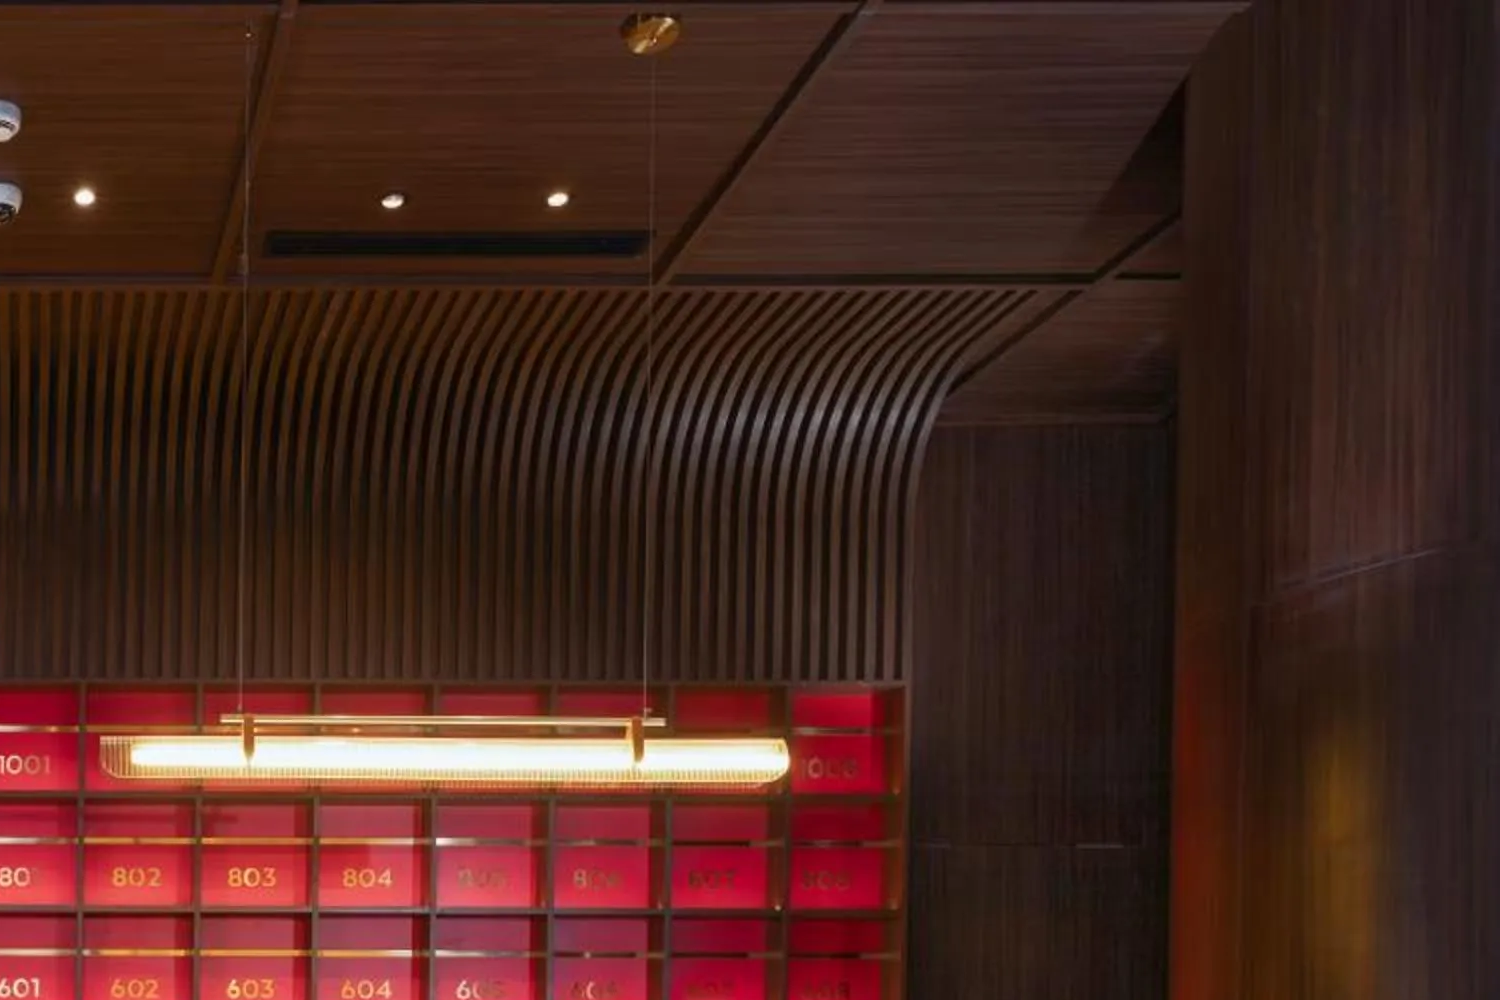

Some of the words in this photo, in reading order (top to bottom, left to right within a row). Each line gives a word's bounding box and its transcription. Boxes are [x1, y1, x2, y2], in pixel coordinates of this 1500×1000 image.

[111, 867, 162, 888] 802
[227, 867, 278, 888] 803
[341, 867, 393, 889] 804
[109, 978, 160, 999] 602
[225, 978, 276, 1000] 603
[340, 978, 392, 1000] 604
